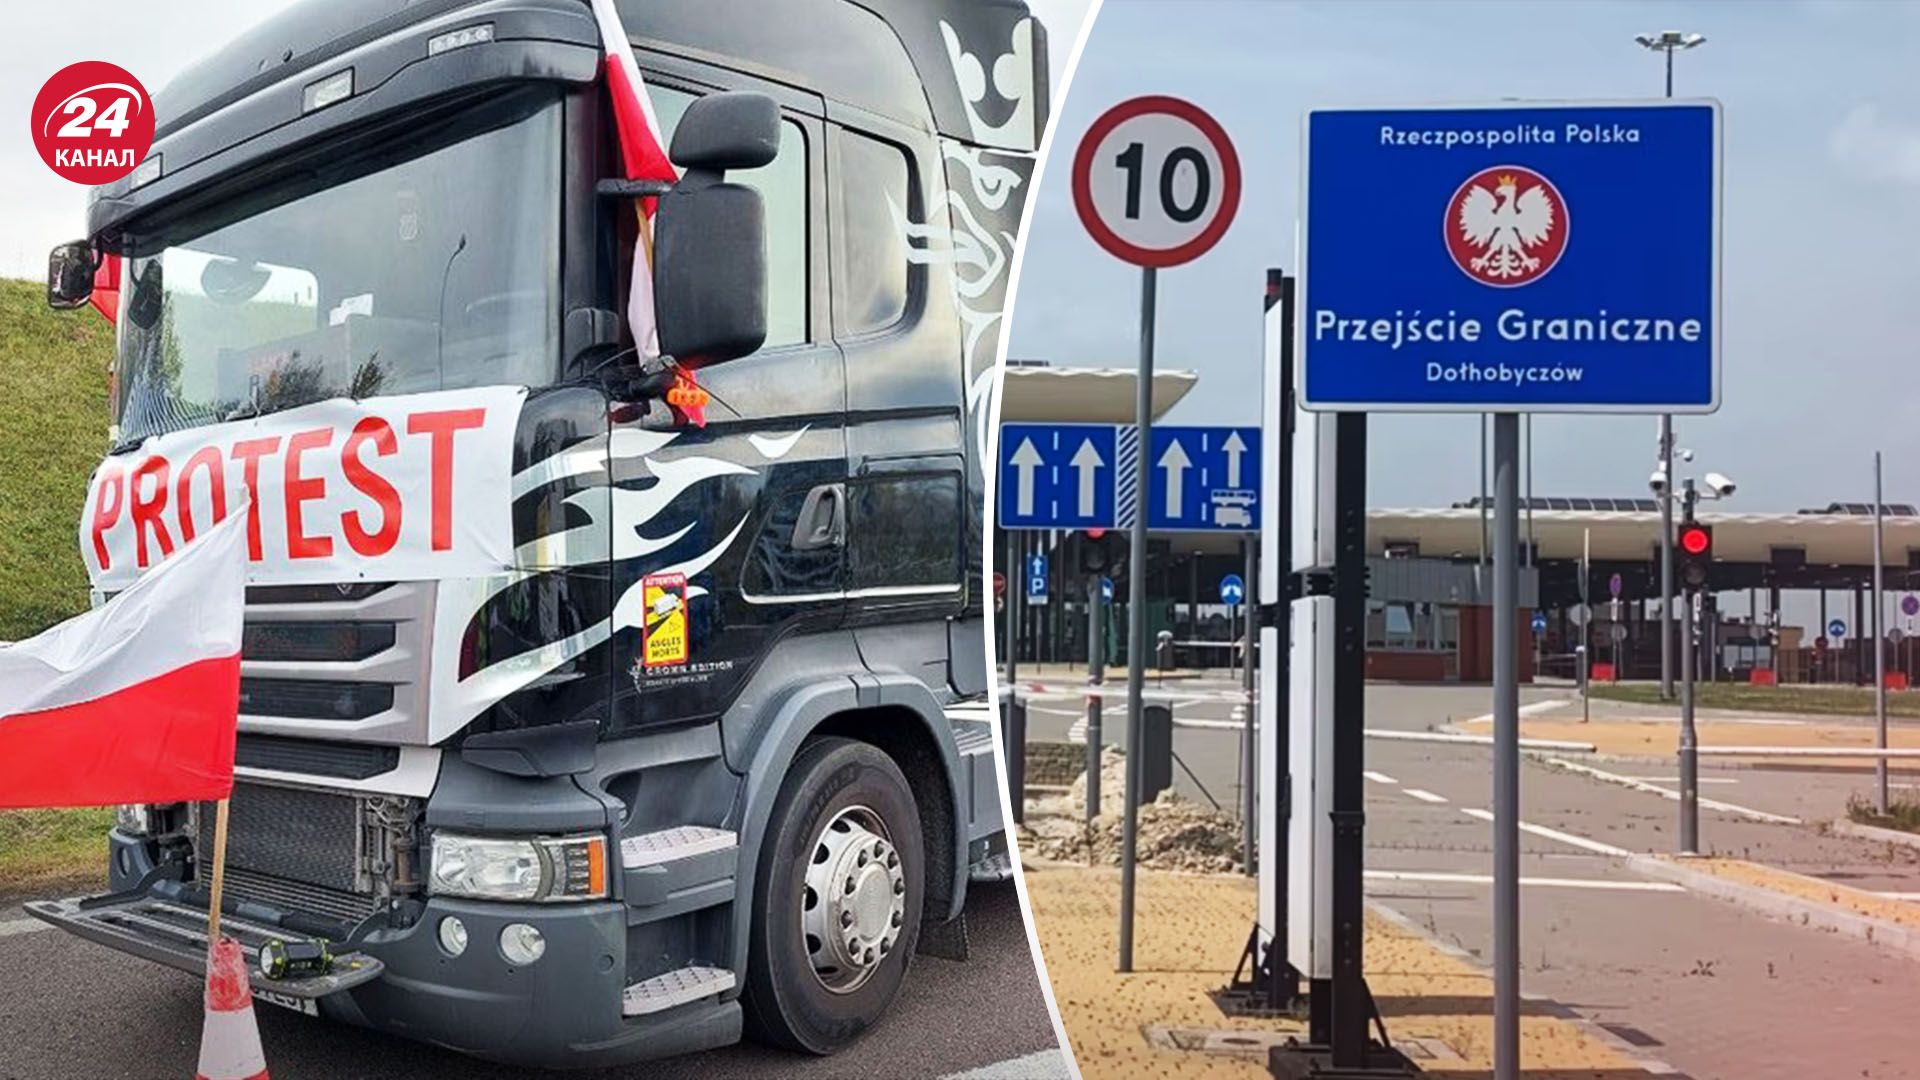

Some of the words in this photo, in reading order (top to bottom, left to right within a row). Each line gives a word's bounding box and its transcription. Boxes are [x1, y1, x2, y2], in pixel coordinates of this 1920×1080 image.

[1381, 125, 1555, 149] Rzeczpospolita
[1566, 124, 1640, 143] Polska
[1116, 142, 1210, 223] 10
[1315, 310, 1481, 349] Przejście
[1497, 309, 1701, 341] Graniczne
[1427, 362, 1583, 386] Dołhobyczów
[92, 408, 487, 570] PROTEST
[1032, 578, 1044, 594] P
[650, 637, 681, 648] ANGLES
[652, 647, 680, 658] MORTS
[646, 665, 687, 676] CROWN
[691, 661, 733, 672] EDITION
